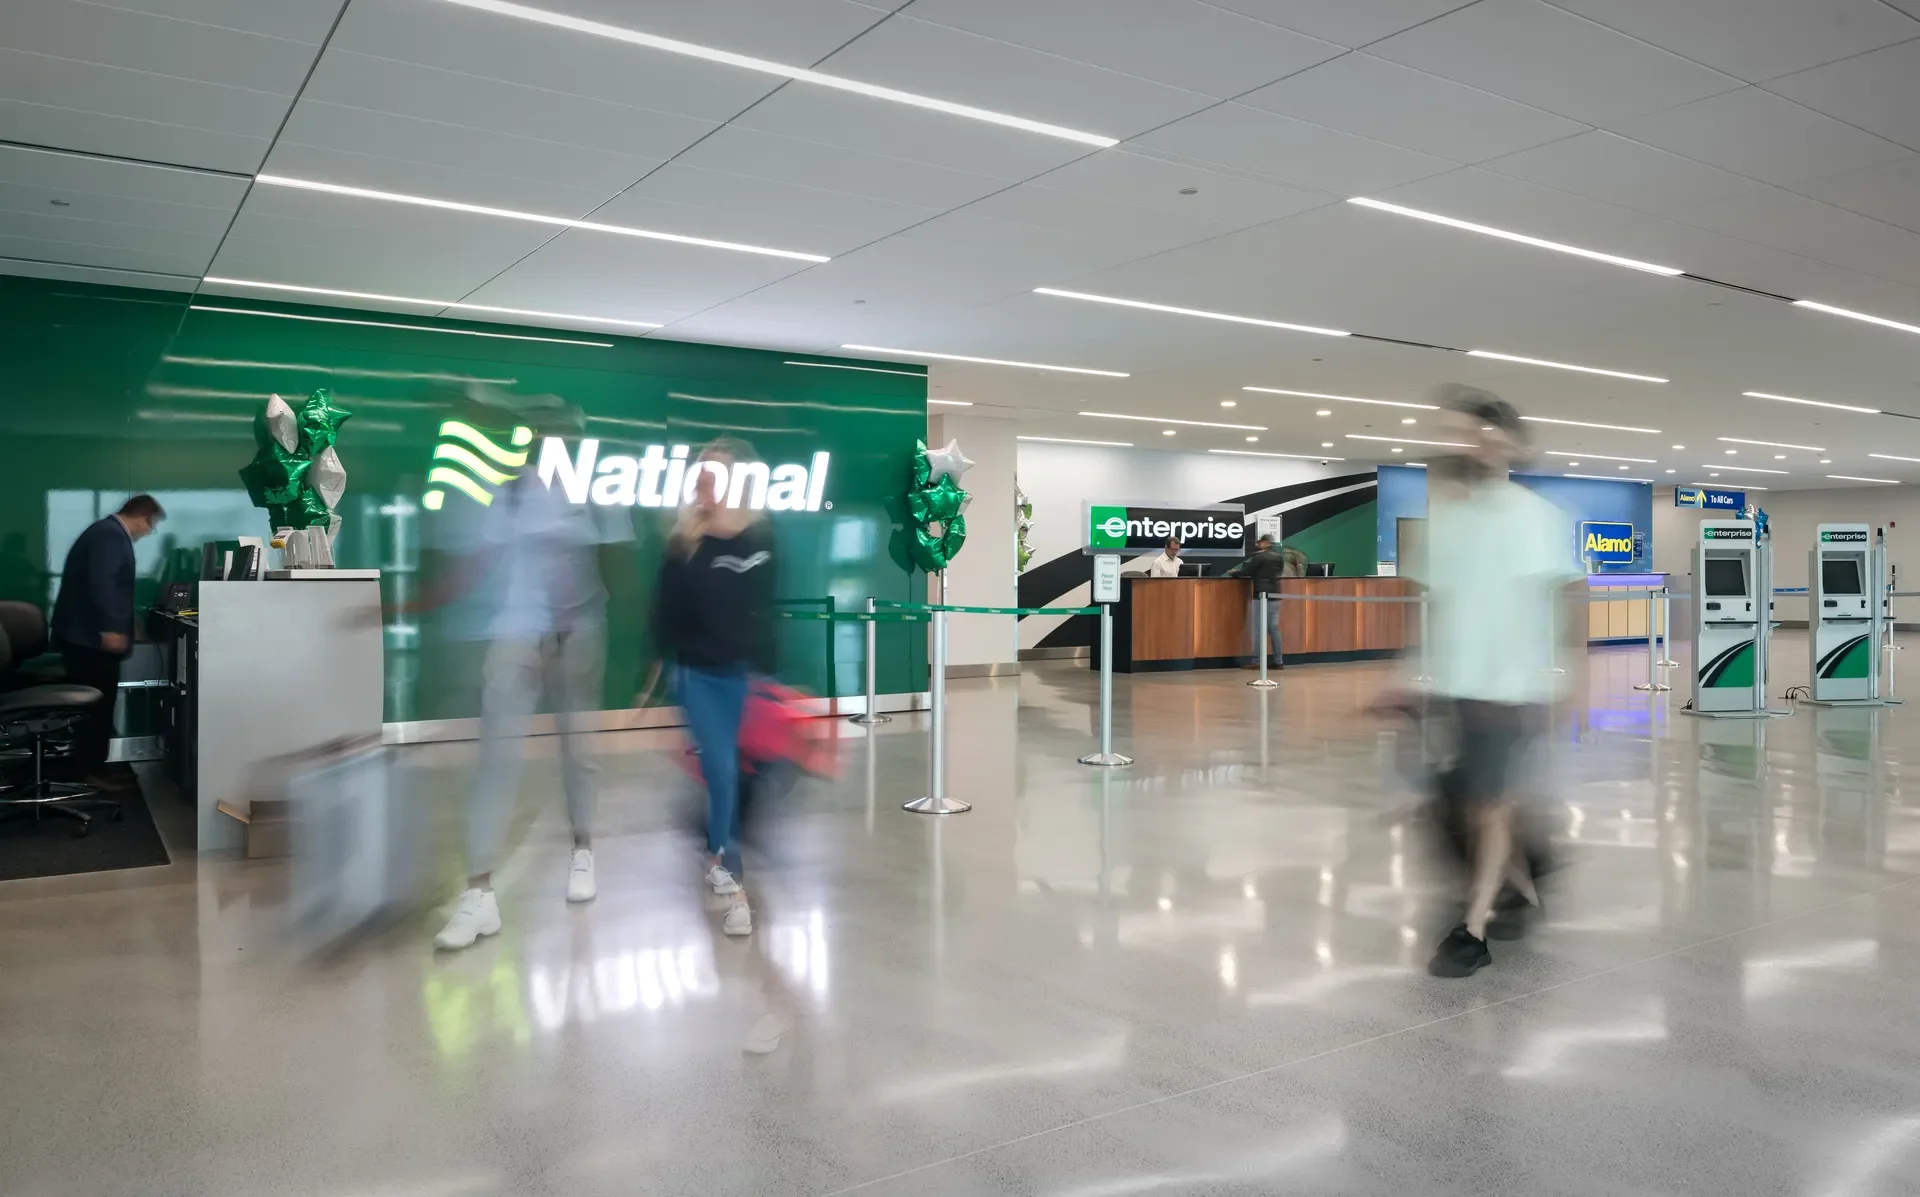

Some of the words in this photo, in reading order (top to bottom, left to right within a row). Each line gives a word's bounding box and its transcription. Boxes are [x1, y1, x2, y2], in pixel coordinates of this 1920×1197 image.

[537, 436, 831, 512] National
[1680, 494, 1696, 502] Alamo
[1711, 495, 1717, 504] To
[1723, 496, 1734, 505] Cars
[1096, 516, 1244, 545] enterprise
[1704, 530, 1752, 538] enterprise
[1821, 532, 1867, 541] enterprise
[1584, 533, 1632, 553] Alamo
